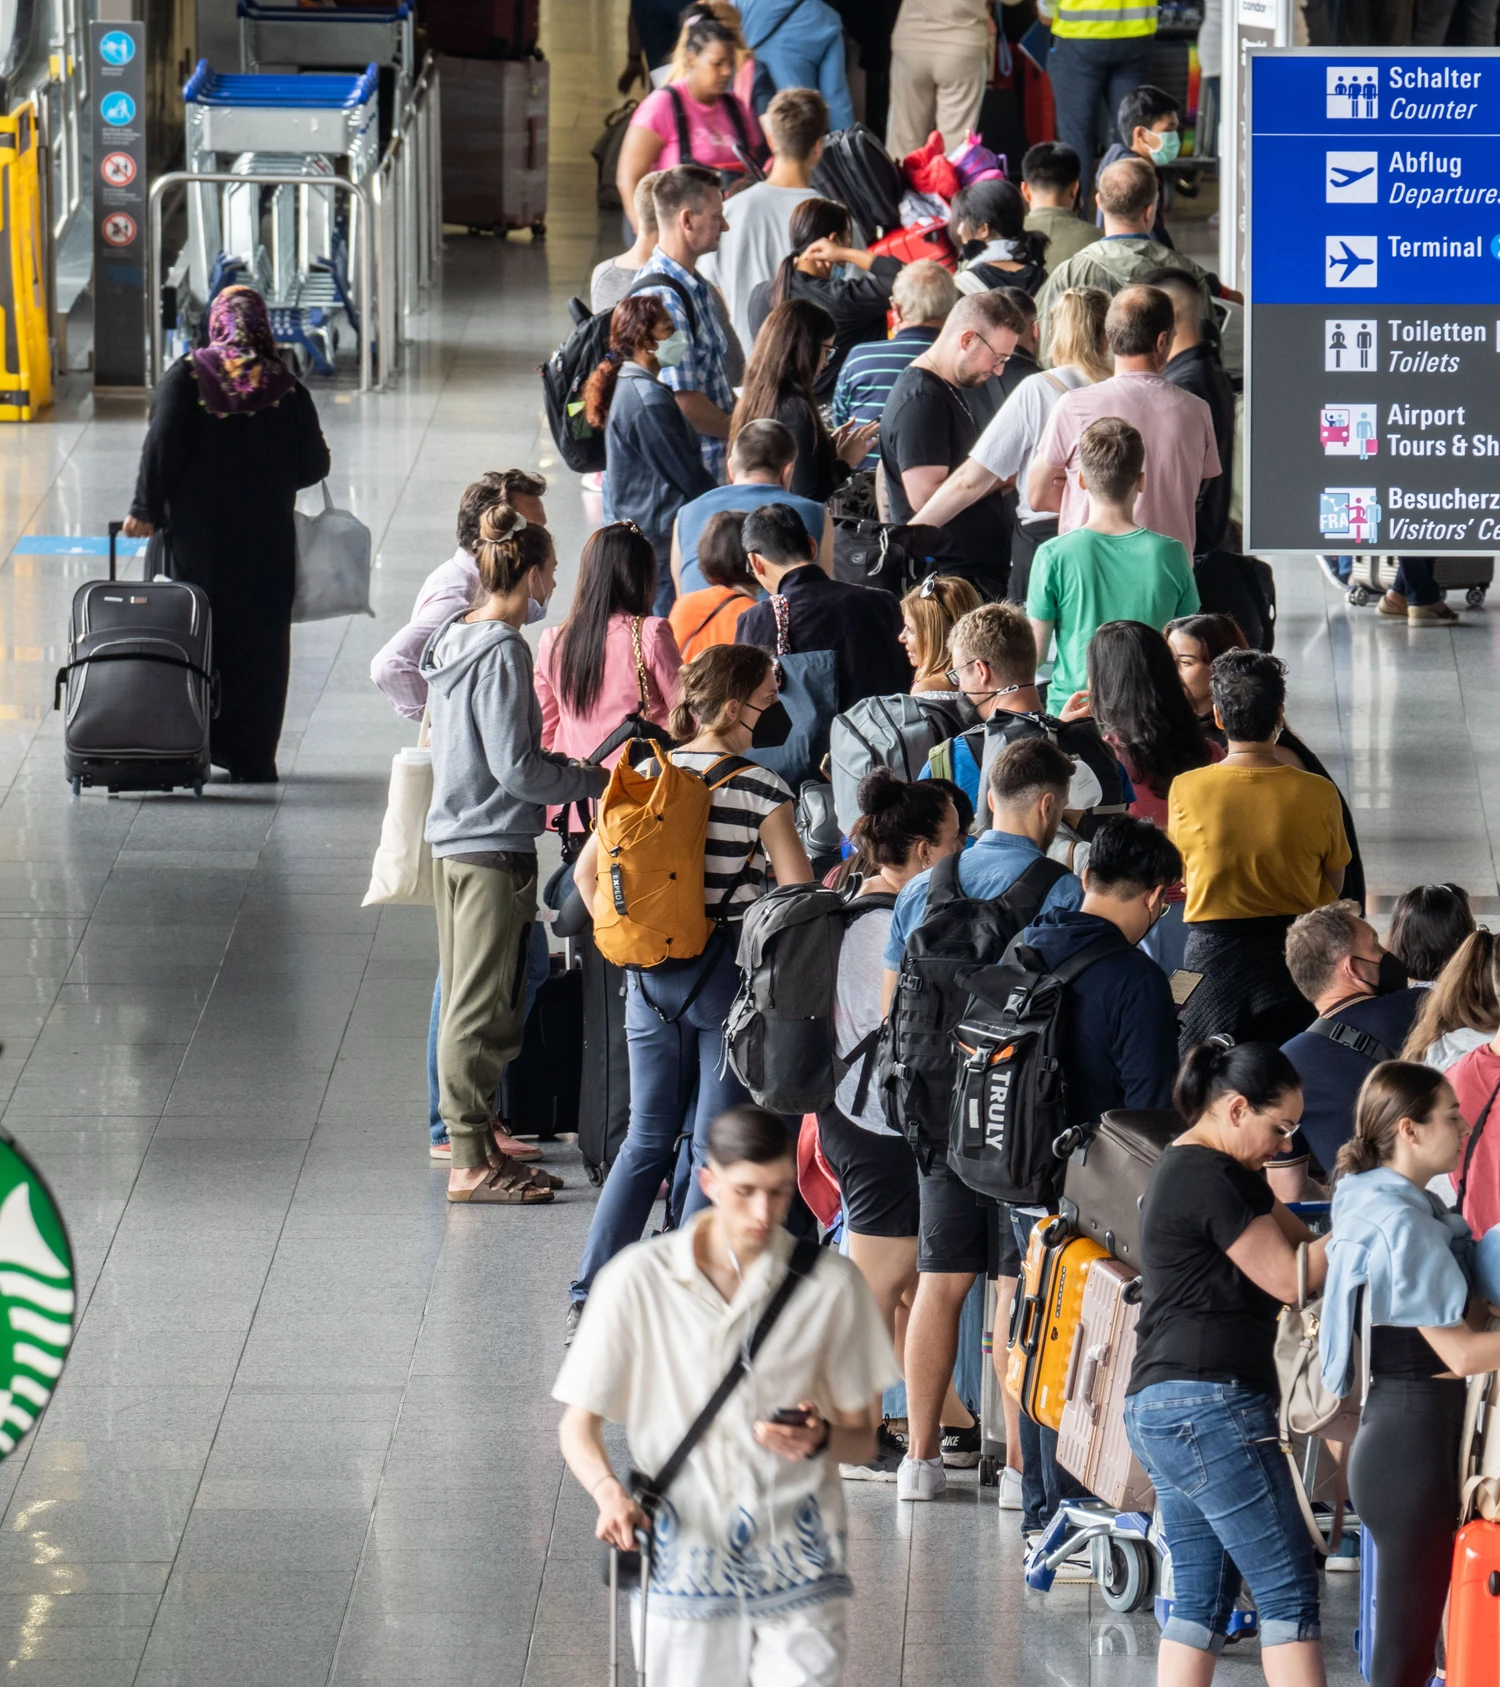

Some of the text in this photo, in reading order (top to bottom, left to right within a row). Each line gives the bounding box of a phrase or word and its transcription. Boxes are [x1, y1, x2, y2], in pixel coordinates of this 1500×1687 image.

[1389, 66, 1482, 89] Schalter
[1390, 97, 1478, 120] Counter
[1389, 151, 1462, 178] Abflug
[1388, 236, 1482, 258] Terminal
[1388, 320, 1487, 342] Toiletten
[1389, 350, 1461, 373] Toilets
[1387, 403, 1466, 430] Airport
[1387, 434, 1447, 457] Tours
[1452, 434, 1469, 457] &
[1319, 513, 1349, 530] FRA
[985, 1070, 1012, 1152] TRULY
